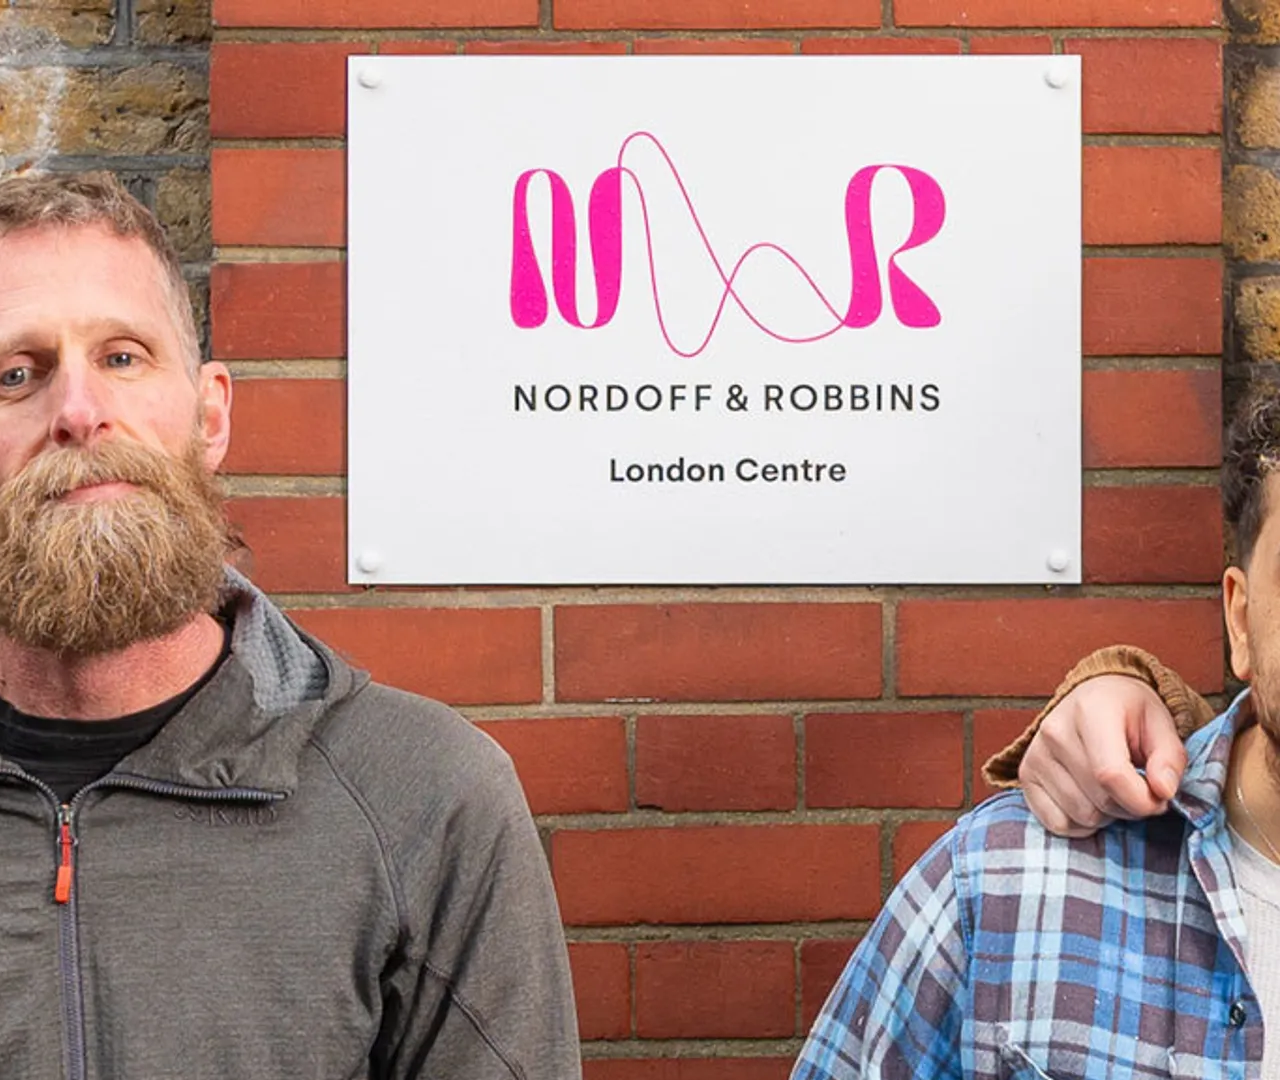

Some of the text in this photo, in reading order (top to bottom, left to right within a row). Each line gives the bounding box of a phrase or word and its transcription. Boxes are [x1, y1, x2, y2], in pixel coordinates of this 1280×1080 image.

[514, 383, 940, 412] NORDOFF & ROBBINS
[610, 457, 847, 483] London Centre
